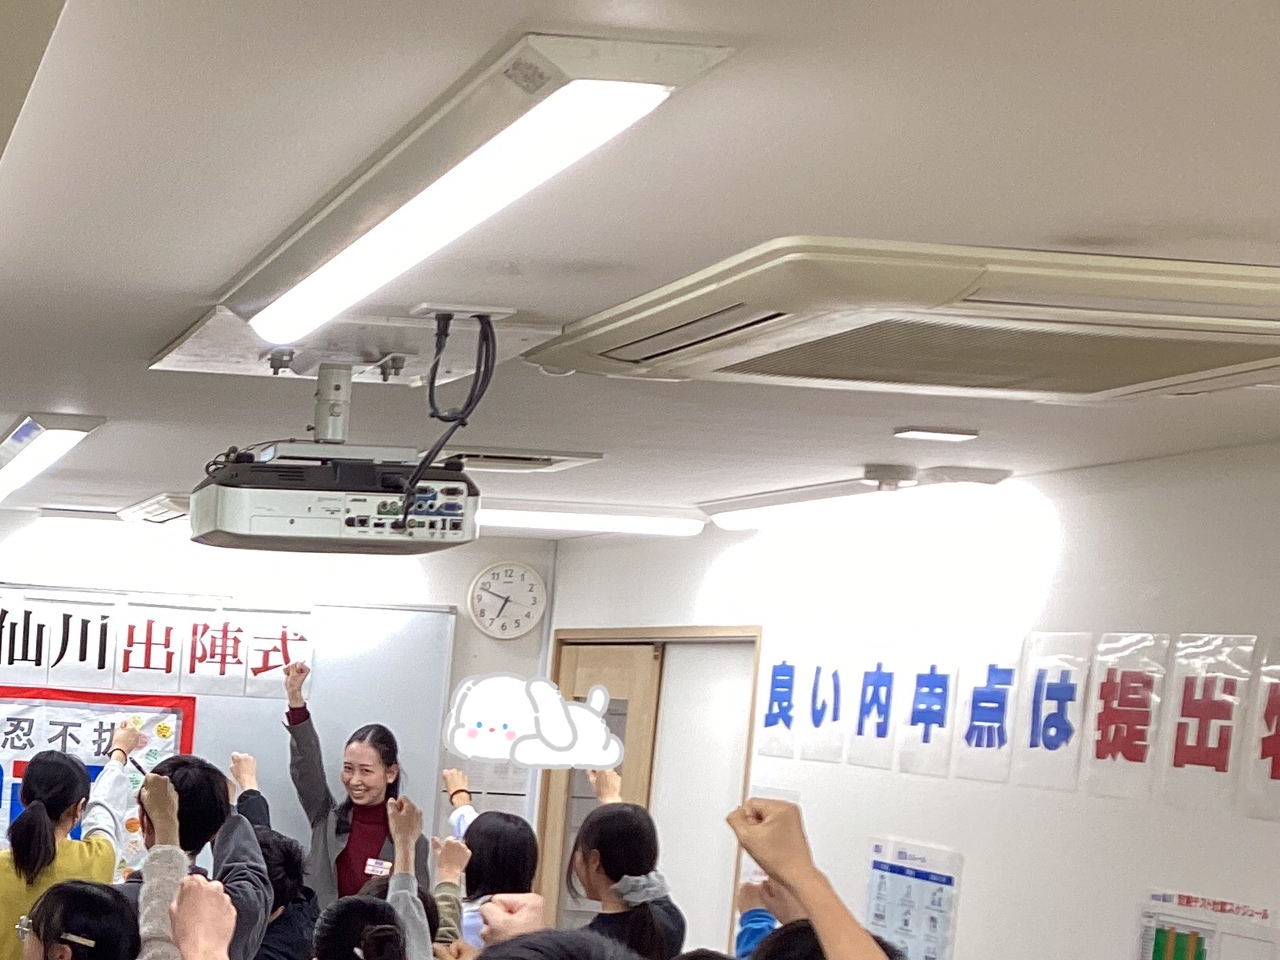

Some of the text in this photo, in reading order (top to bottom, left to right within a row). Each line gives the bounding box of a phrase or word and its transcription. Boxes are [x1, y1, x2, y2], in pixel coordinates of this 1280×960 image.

[504, 569, 514, 578] 12
[528, 584, 535, 592] 2
[477, 594, 482, 603] 9
[531, 597, 537, 605] 3
[480, 609, 485, 618] 8
[489, 618, 495, 626] 7
[514, 619, 520, 628] 5
[501, 623, 507, 631] 6
